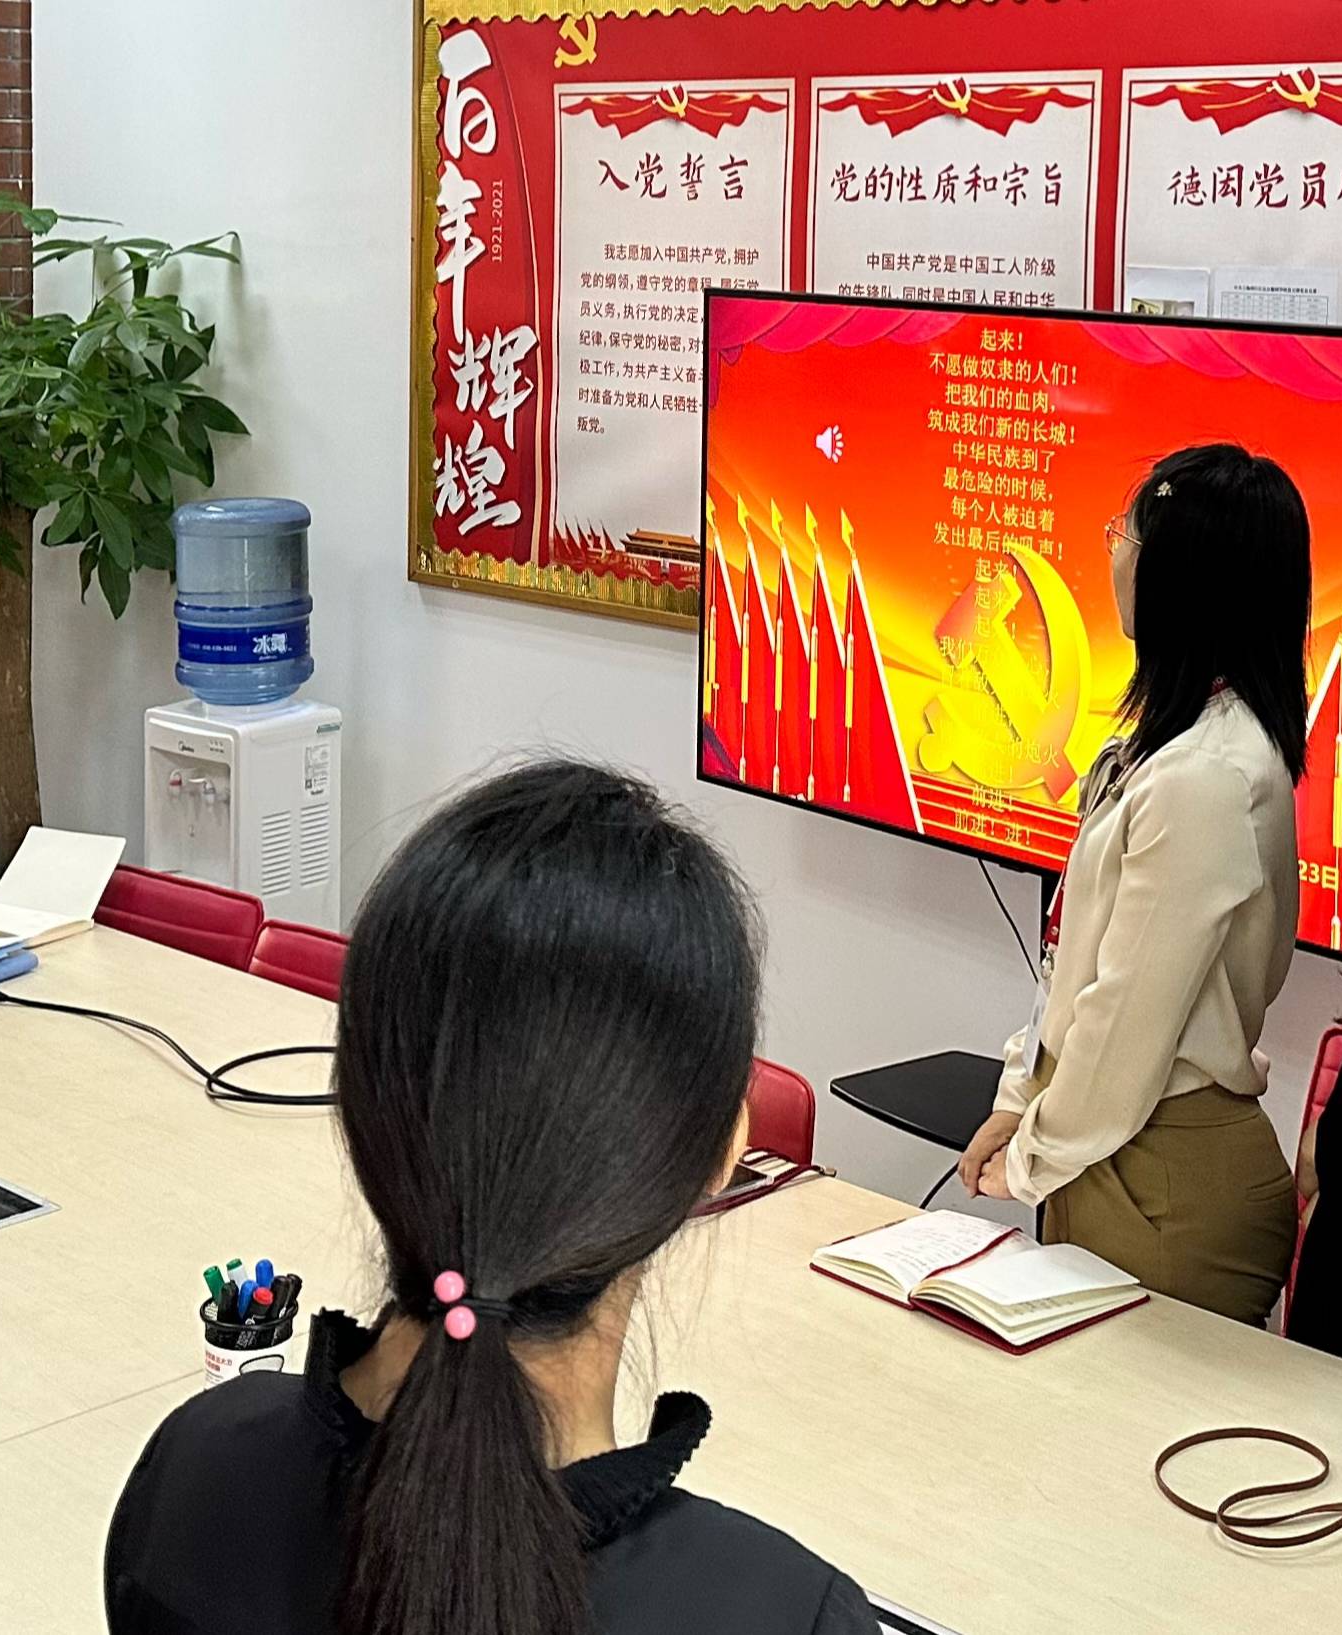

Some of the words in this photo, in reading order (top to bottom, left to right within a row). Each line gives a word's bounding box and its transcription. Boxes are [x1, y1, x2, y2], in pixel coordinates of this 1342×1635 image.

[598, 151, 750, 202] 入党誓言
[830, 161, 1064, 208] 党的性质和宗旨
[489, 179, 505, 264] 1921-2021
[865, 251, 1057, 277] 中国共产党是中国工人阶级
[979, 327, 1024, 352] 起来！
[952, 440, 1057, 474] 中华民族到了
[950, 495, 1056, 533] 每个人被迫着
